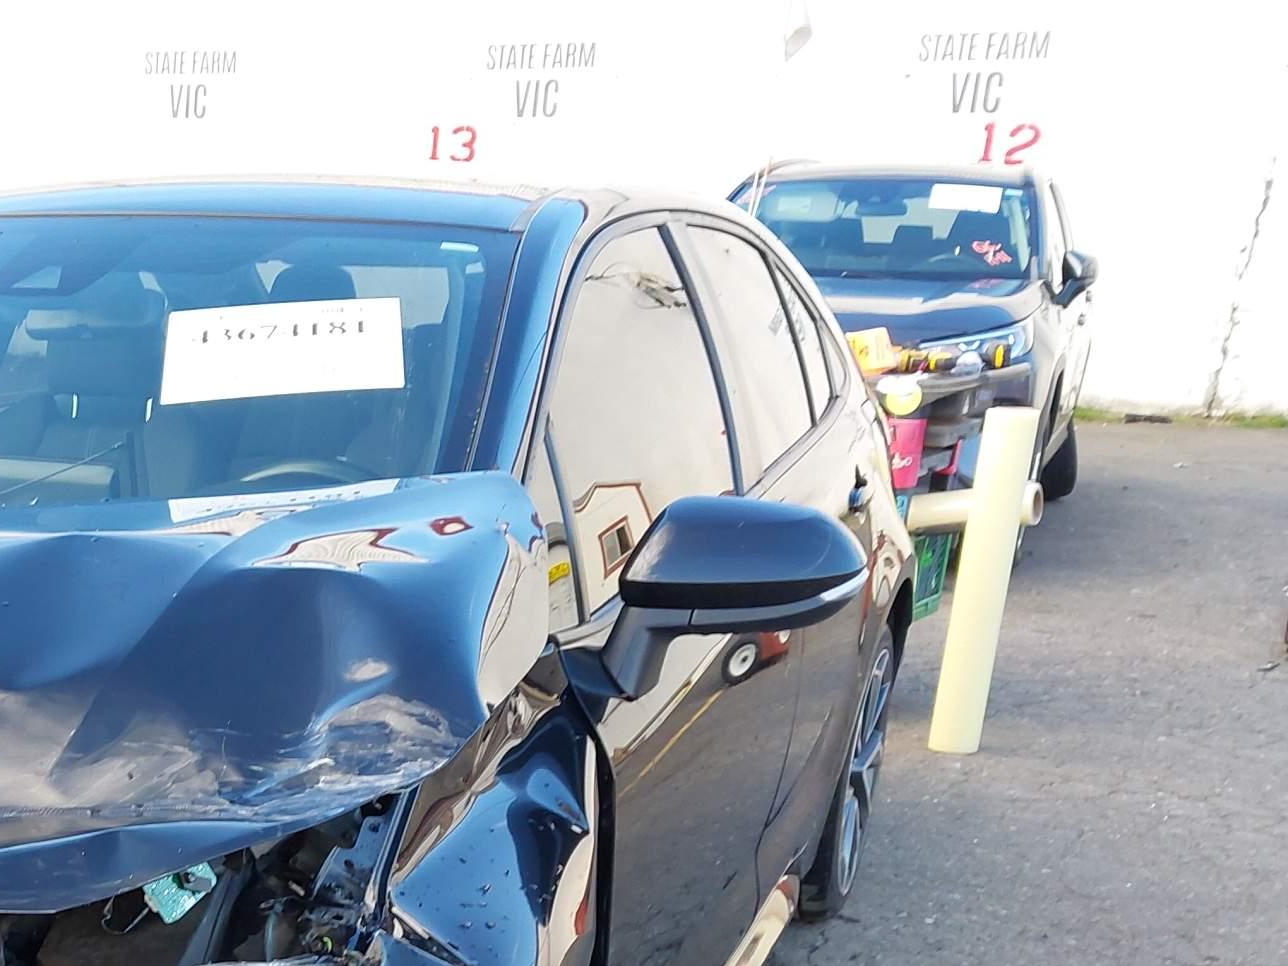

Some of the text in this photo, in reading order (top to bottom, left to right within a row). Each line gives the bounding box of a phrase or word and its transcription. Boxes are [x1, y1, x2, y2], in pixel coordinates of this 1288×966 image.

[146, 51, 237, 75] STATE FARM
[487, 42, 596, 71] STATE FARM
[919, 31, 1051, 62] STATE FARM
[170, 83, 207, 119] VIC
[516, 79, 559, 118] VIC
[951, 71, 1004, 114] VIC
[428, 124, 477, 163] 13
[978, 121, 1042, 165] 12
